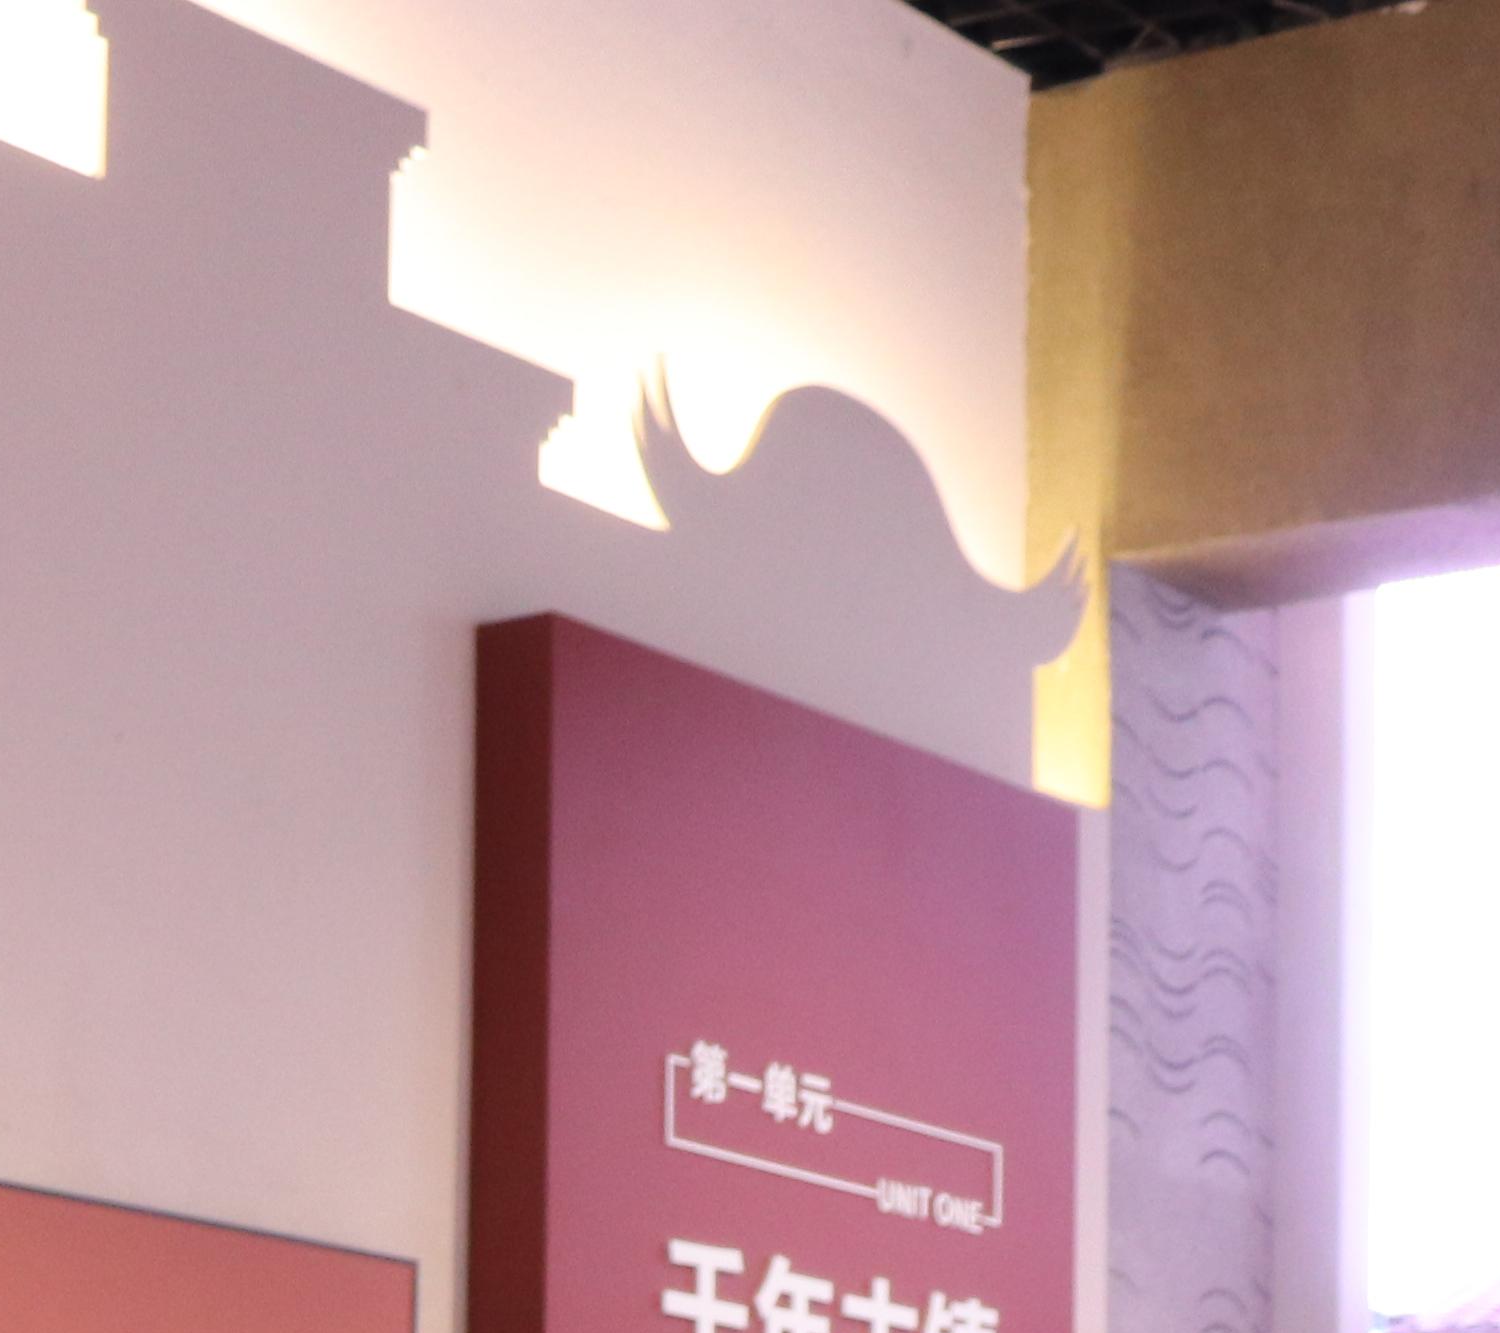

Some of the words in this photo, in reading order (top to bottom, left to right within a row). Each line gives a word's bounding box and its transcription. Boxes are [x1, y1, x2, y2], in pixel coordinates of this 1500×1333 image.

[690, 1040, 833, 1135] 第一单元
[876, 1178, 931, 1220] UNIT
[933, 1192, 983, 1235] ONE
